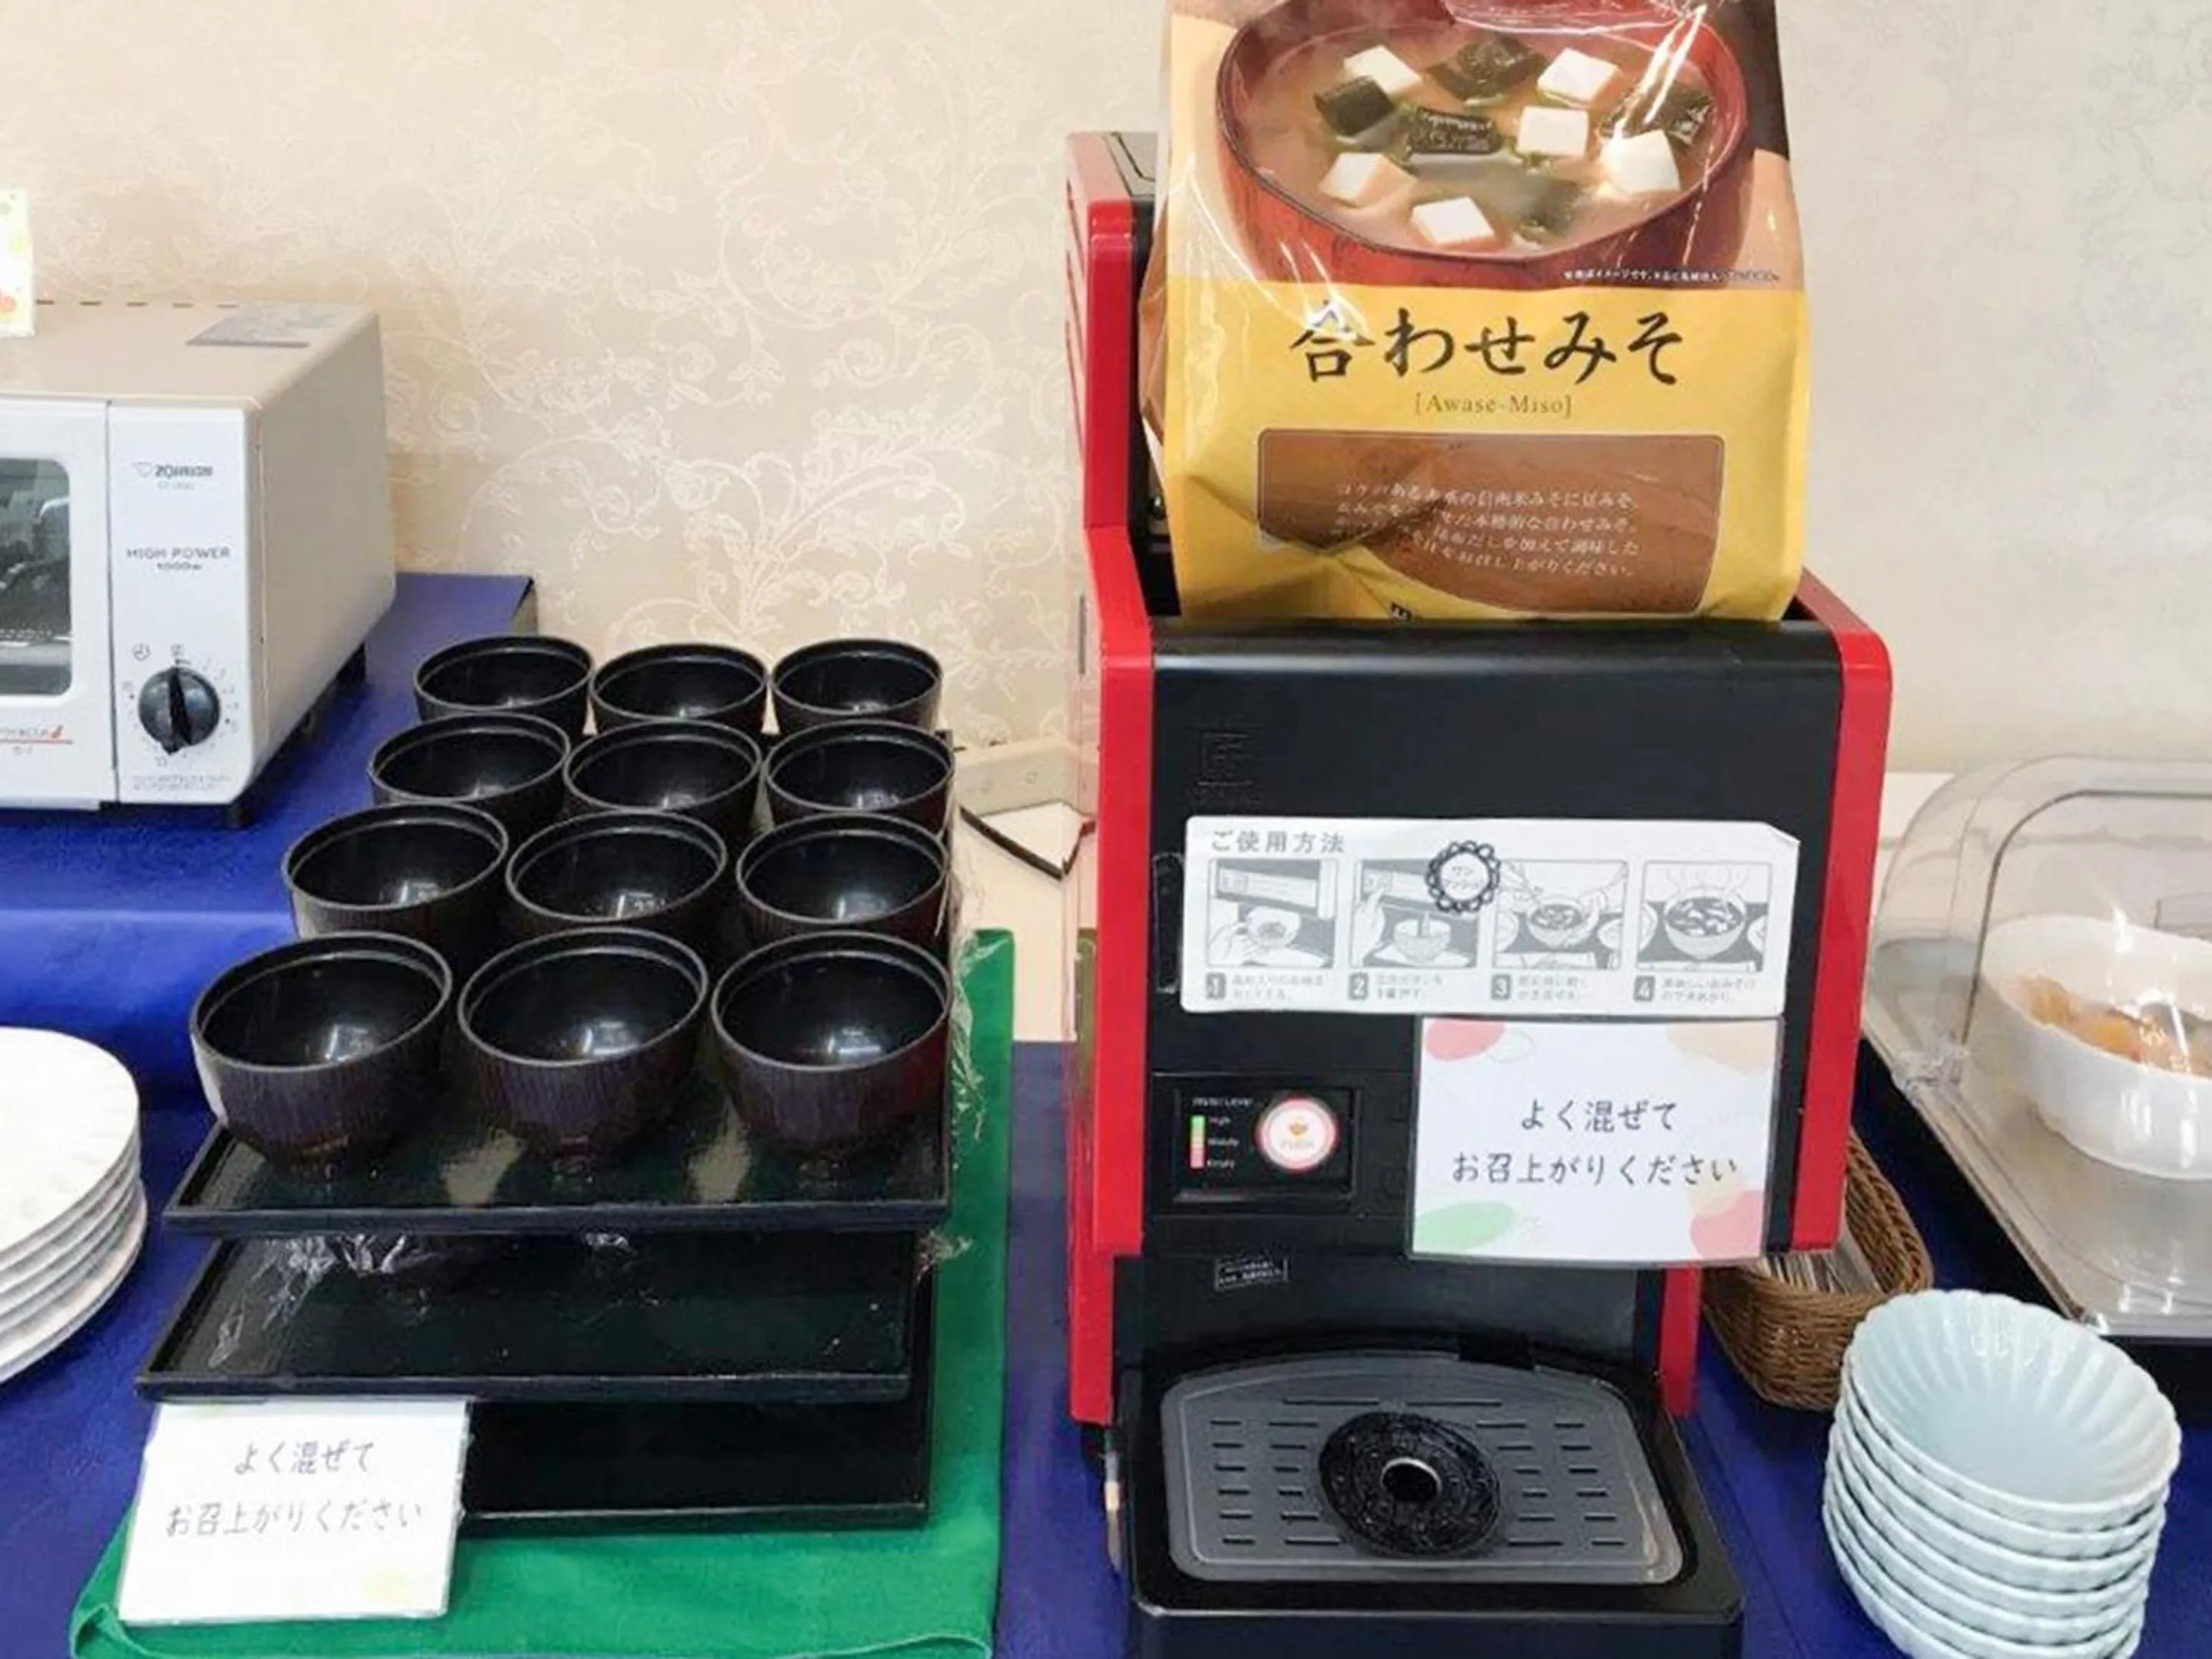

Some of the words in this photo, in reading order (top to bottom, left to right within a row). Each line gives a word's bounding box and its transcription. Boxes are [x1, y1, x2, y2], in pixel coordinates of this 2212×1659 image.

[1290, 300, 1683, 384] 合わせみそ
[127, 547, 167, 559] HIGH
[171, 546, 230, 559] POWER
[1212, 830, 1345, 854] ご使用方法
[1522, 1098, 1677, 1133] よく混ぜて
[1452, 1152, 1737, 1187] お召上がりください
[235, 1439, 375, 1475] よく混ぜて
[166, 1497, 422, 1537] お召上がりください
